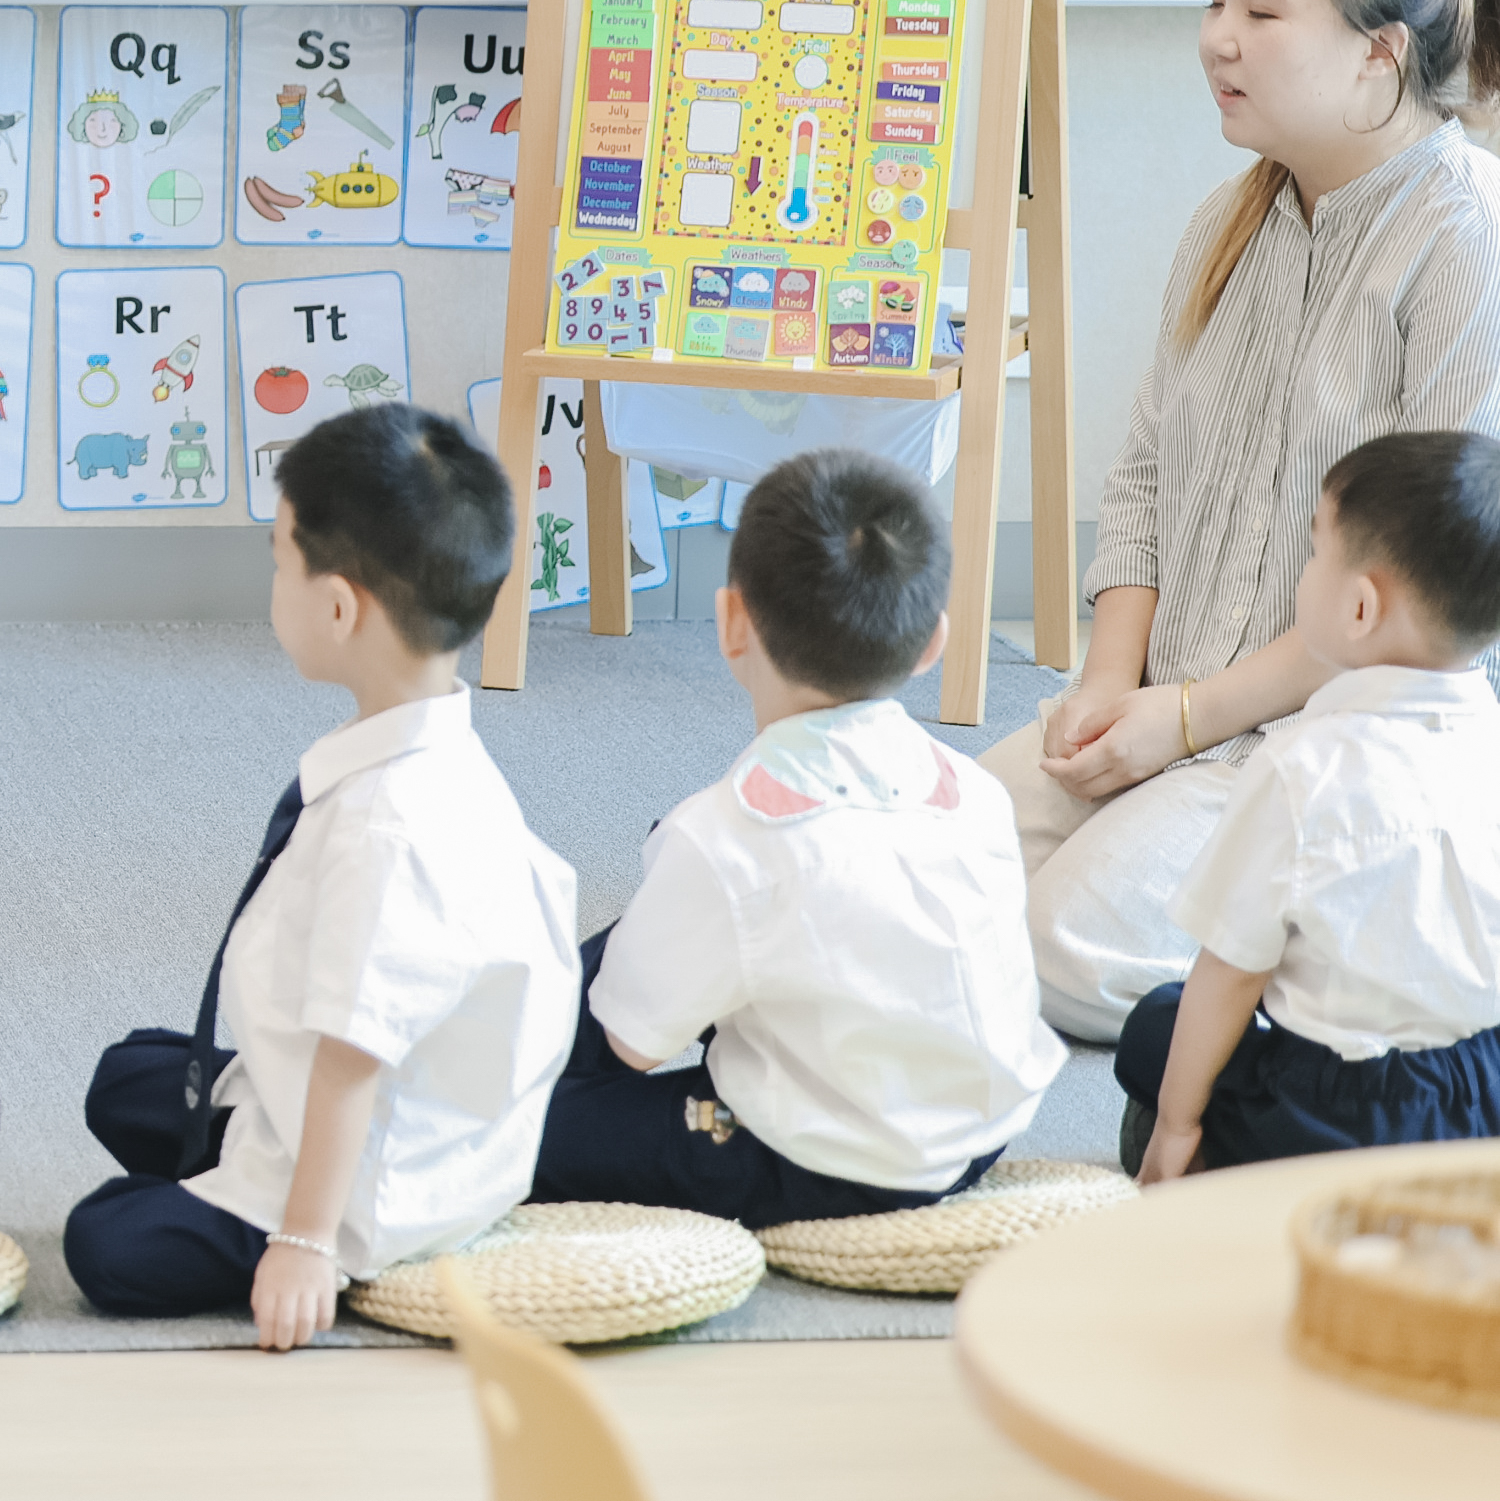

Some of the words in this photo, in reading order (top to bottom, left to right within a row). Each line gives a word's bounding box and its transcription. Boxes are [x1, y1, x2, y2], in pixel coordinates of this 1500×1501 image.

[898, 0, 940, 15] Monday
[601, 15, 647, 28] February
[896, 18, 940, 34] Tuesday
[607, 34, 638, 45] March
[710, 32, 734, 49] Day
[295, 30, 351, 71] Ss
[464, 34, 525, 75] Uu
[608, 50, 635, 64] April
[109, 32, 181, 85] Qq
[609, 69, 631, 83] May
[891, 63, 939, 77] Thursday
[607, 88, 632, 100] June
[697, 84, 738, 98] Season
[892, 84, 925, 100] Friday
[776, 92, 844, 108] Temperature
[608, 105, 629, 117] July
[884, 106, 932, 120] Saturday
[590, 123, 642, 136] September
[885, 125, 923, 140] Sunday
[597, 141, 631, 154] August
[894, 151, 919, 162] Feel
[590, 160, 631, 174] October
[687, 157, 733, 171] Weather
[584, 178, 635, 192] November
[583, 196, 633, 209] December
[579, 212, 636, 230] Wednesday
[606, 249, 639, 261] Dates
[731, 249, 782, 260] Weathers
[617, 280, 630, 296] 3
[696, 296, 724, 307] Snowy
[736, 296, 768, 308] Cloudy
[779, 297, 808, 309] Windy
[115, 296, 171, 335] Rr
[566, 300, 577, 316] 8
[591, 298, 603, 315] 9
[614, 304, 626, 321] 4
[639, 303, 650, 320] 5
[880, 312, 913, 321] Summer
[293, 304, 349, 344] Tt
[566, 324, 578, 340] 9
[725, 344, 763, 358] Thunder
[834, 353, 868, 363] Autumn
[874, 354, 908, 365] Winter
